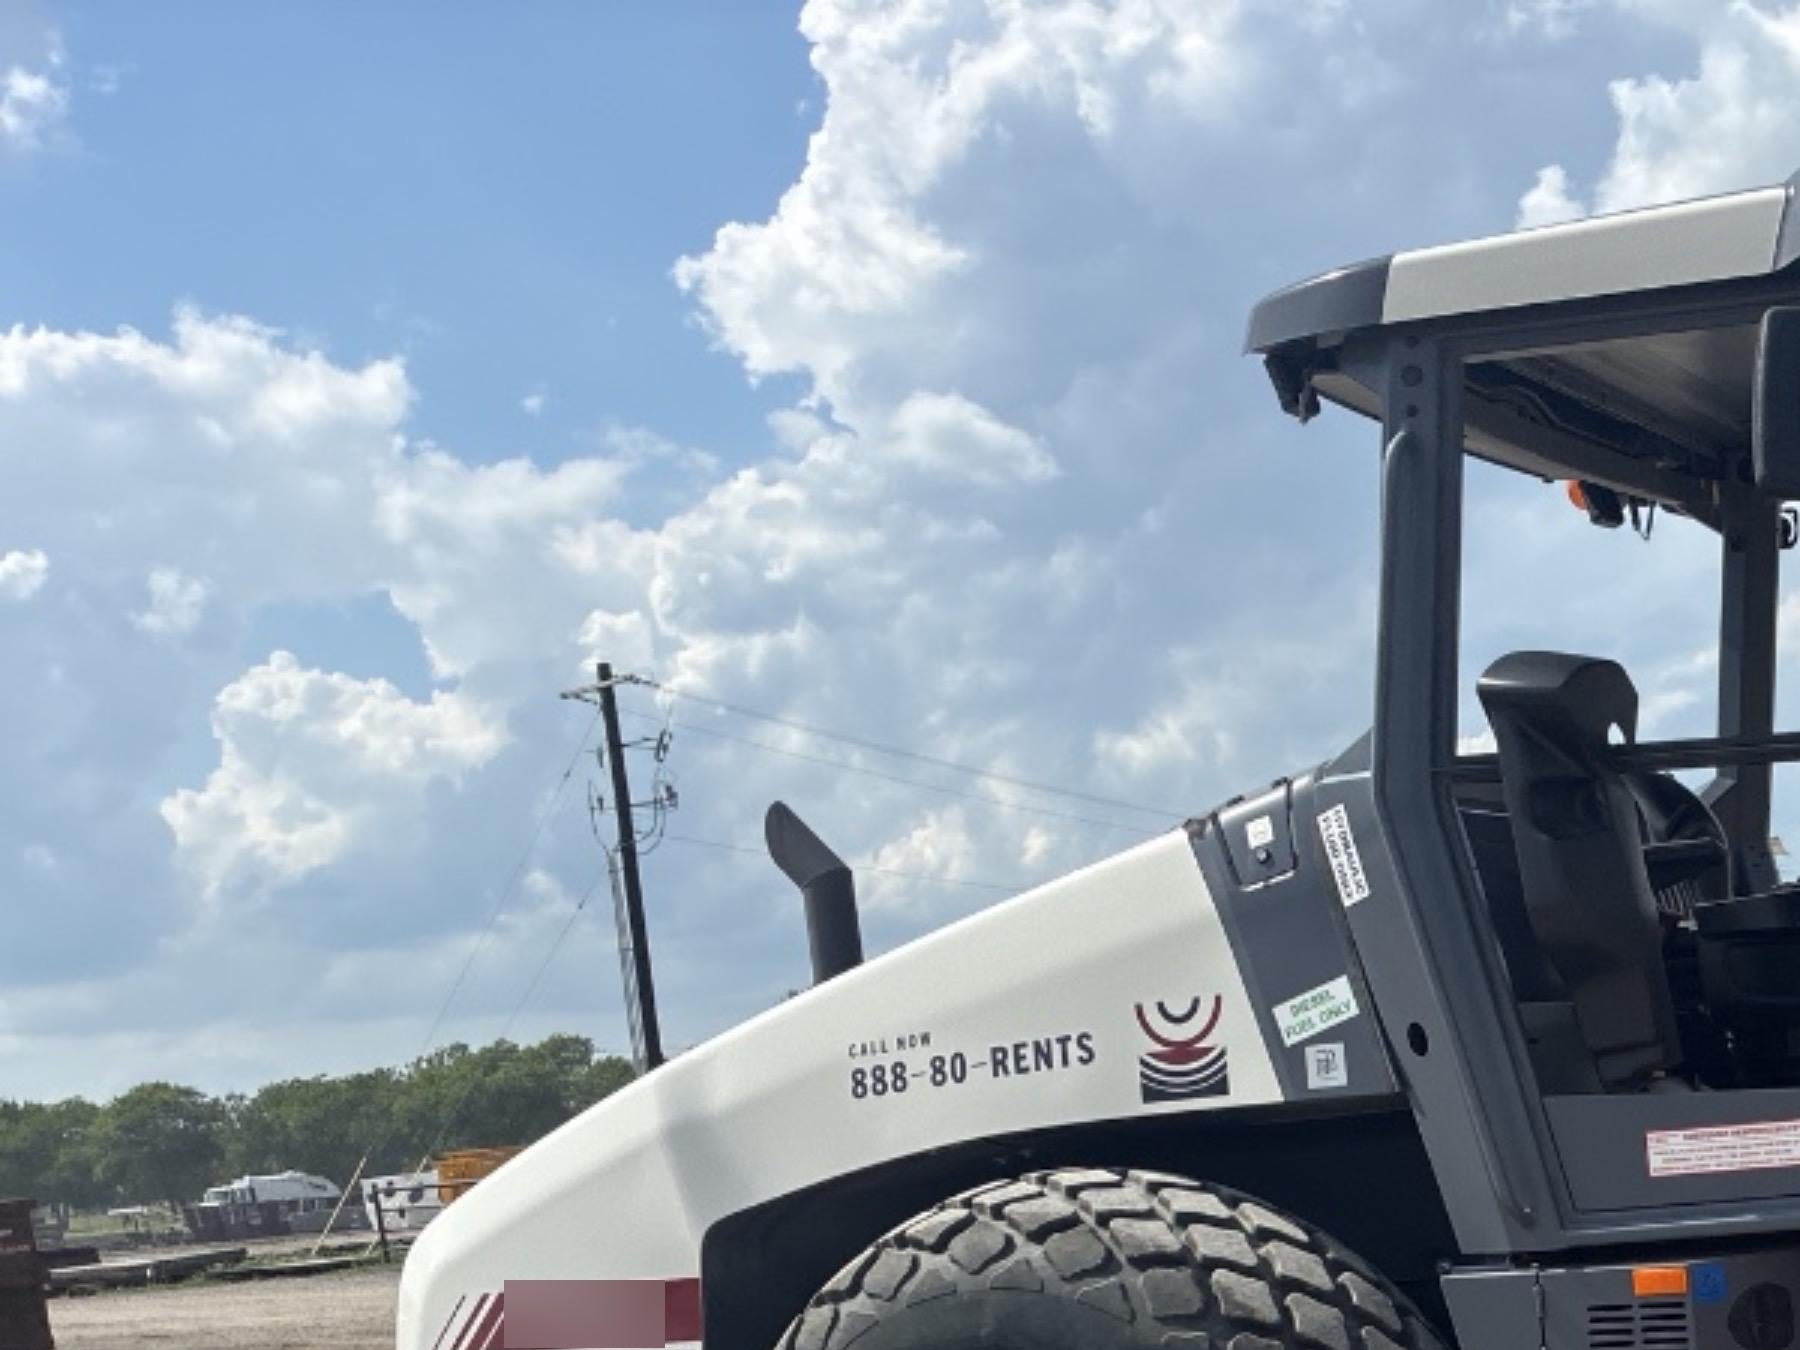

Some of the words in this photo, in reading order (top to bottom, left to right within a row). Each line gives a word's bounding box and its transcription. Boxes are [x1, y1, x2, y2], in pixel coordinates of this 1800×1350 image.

[848, 1040, 889, 1059] CALL
[896, 1032, 931, 1051] NOW
[851, 1031, 1096, 1099] 888-80-RENTS
